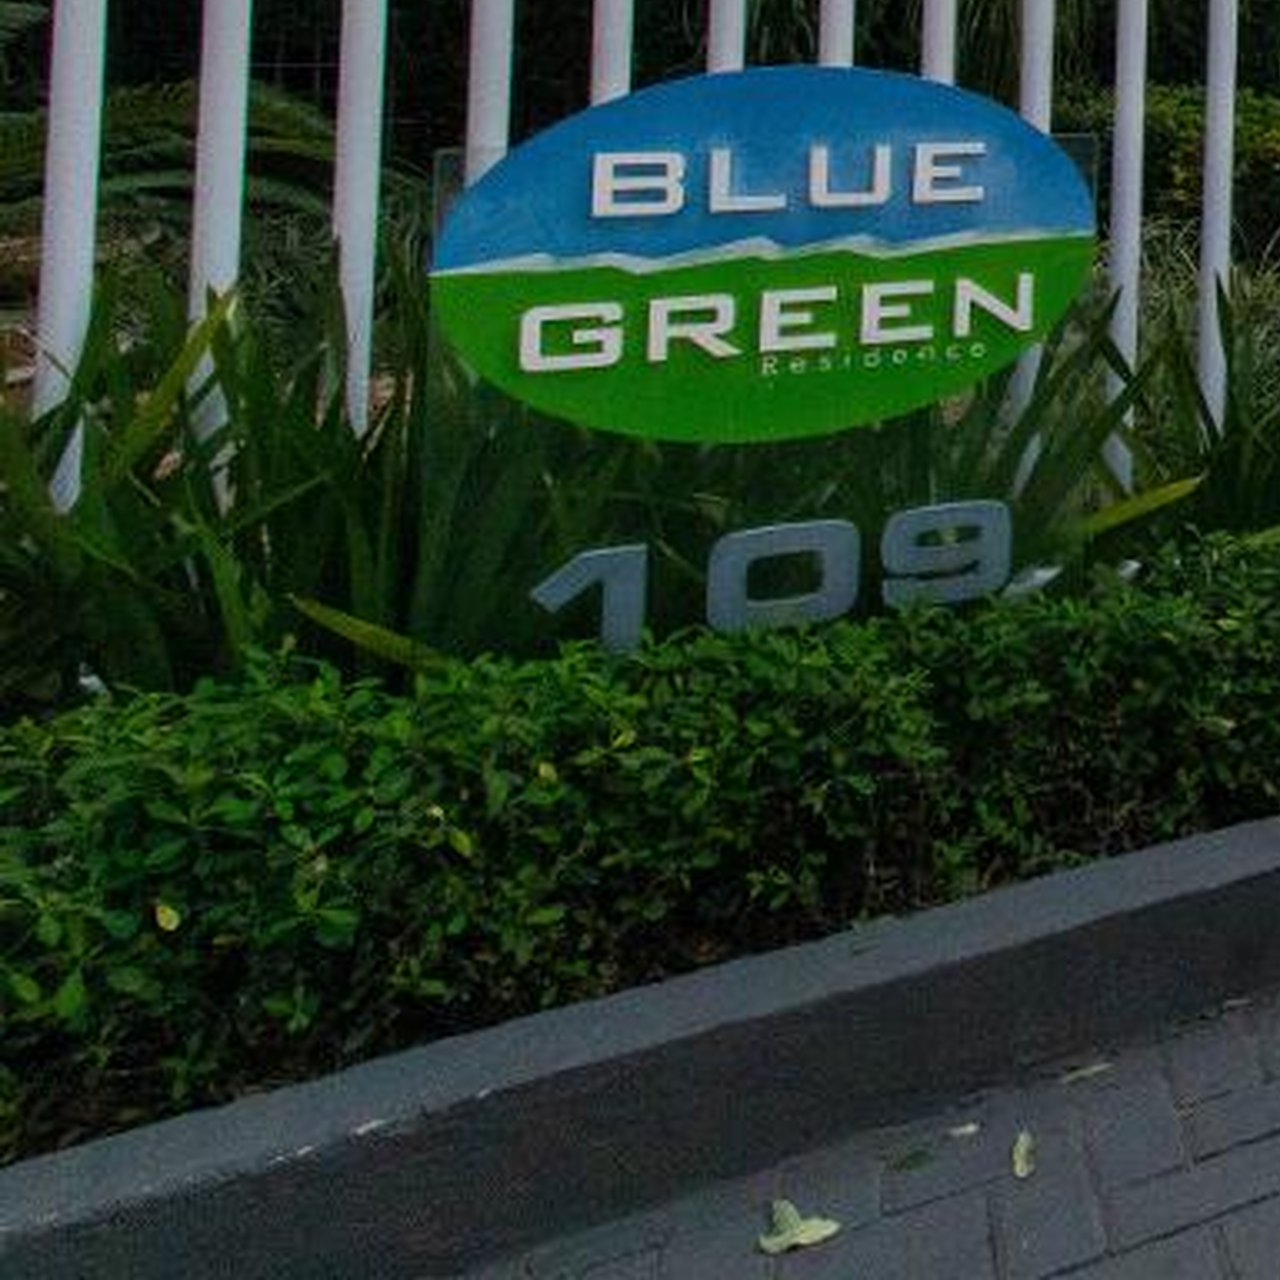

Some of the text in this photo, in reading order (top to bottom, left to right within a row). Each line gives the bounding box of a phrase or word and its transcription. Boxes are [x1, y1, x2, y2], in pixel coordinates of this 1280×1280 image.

[590, 141, 987, 218] BLUE
[518, 271, 1036, 373] GREEN
[530, 499, 1014, 655] 109
